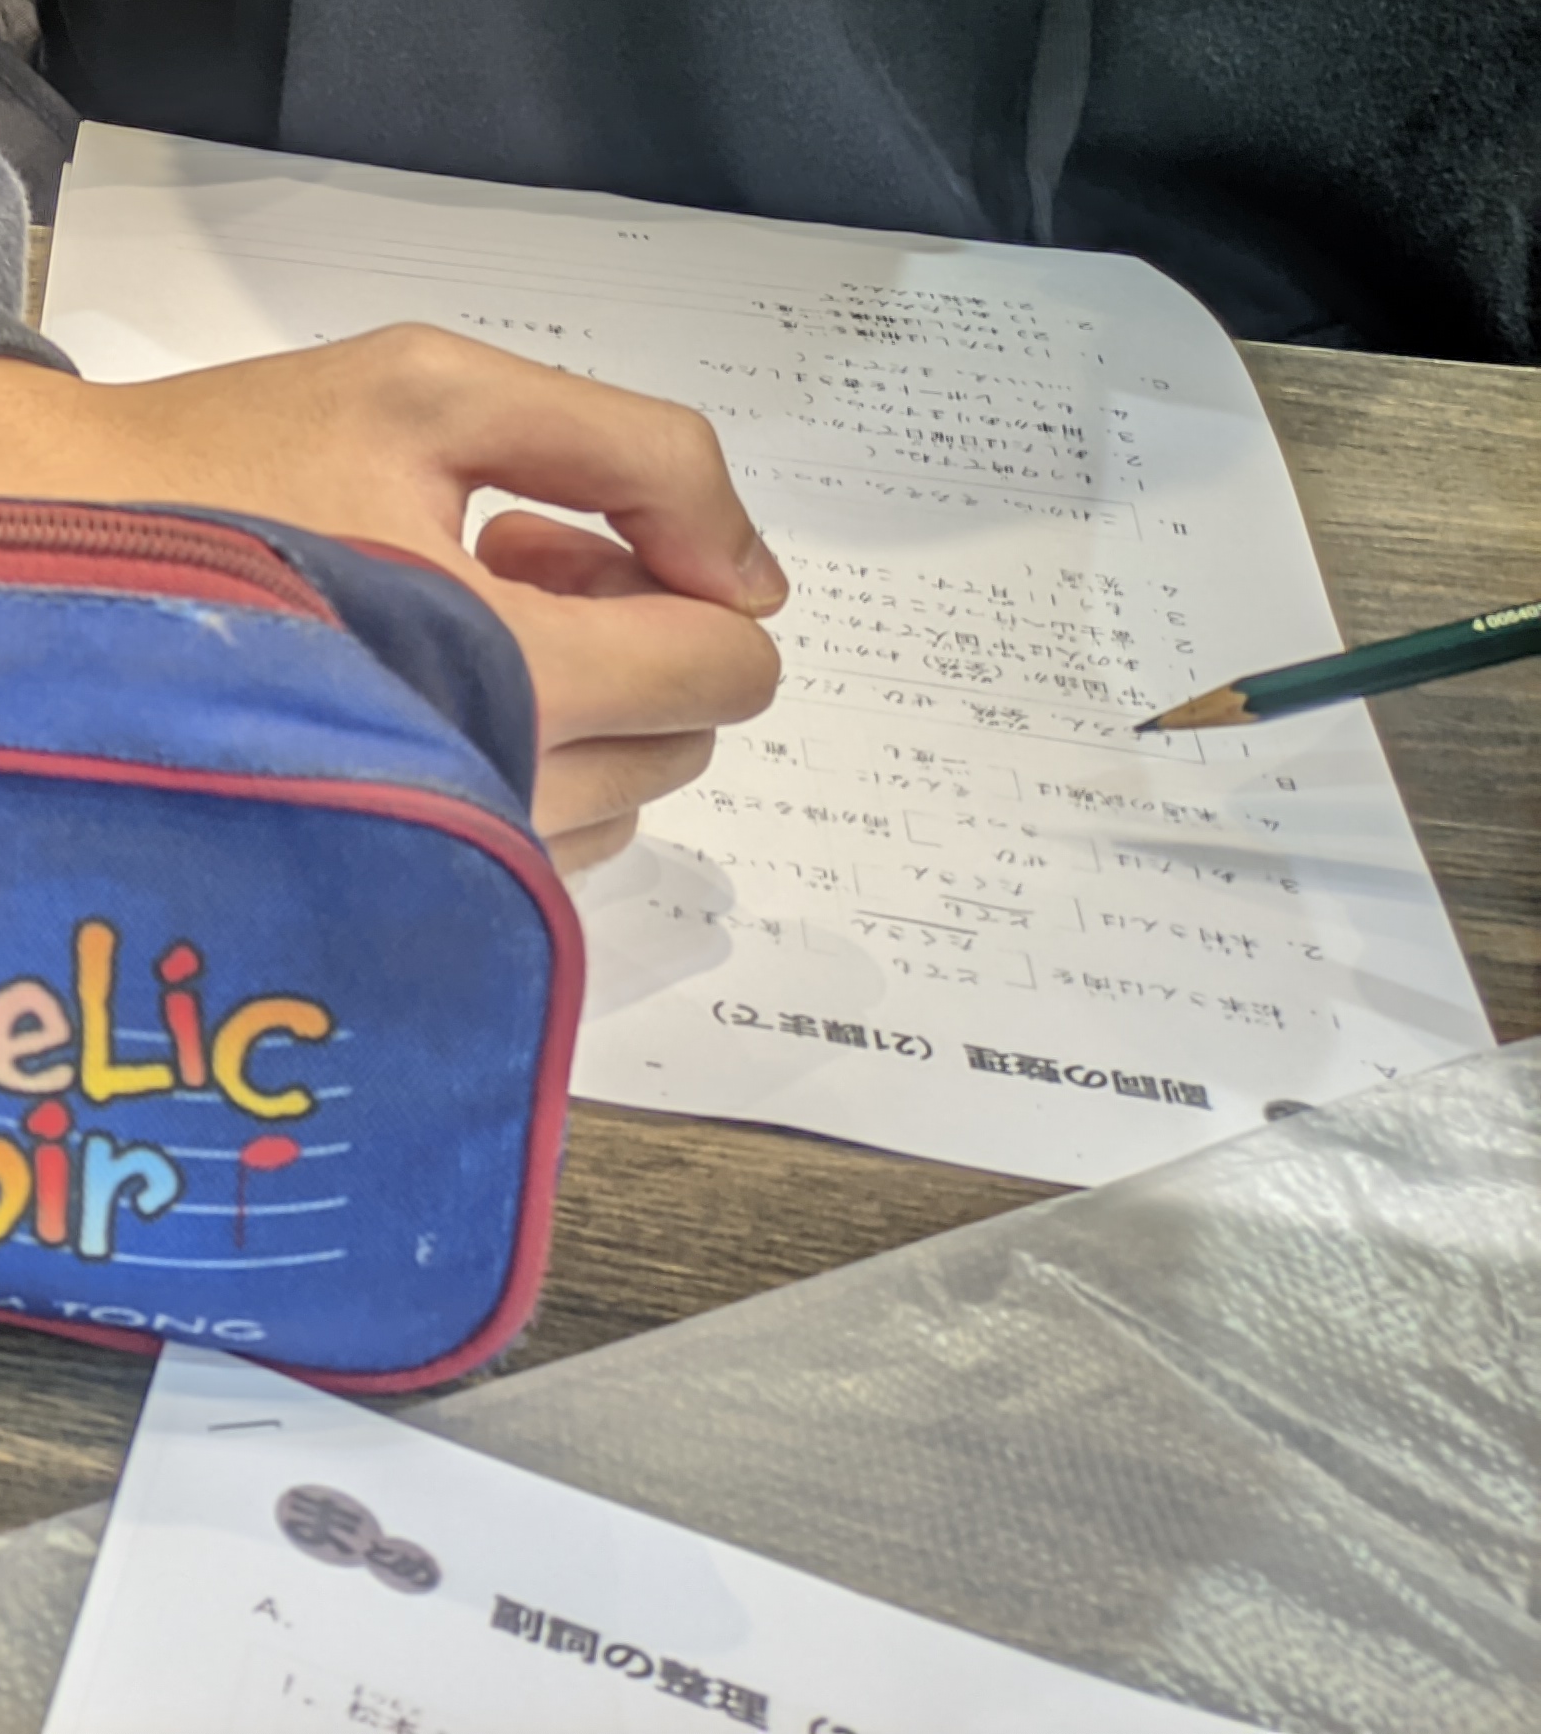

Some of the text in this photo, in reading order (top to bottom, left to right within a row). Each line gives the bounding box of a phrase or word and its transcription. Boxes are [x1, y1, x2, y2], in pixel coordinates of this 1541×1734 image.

[891, 957, 978, 985] とても
[59, 1300, 267, 1342] TONG
